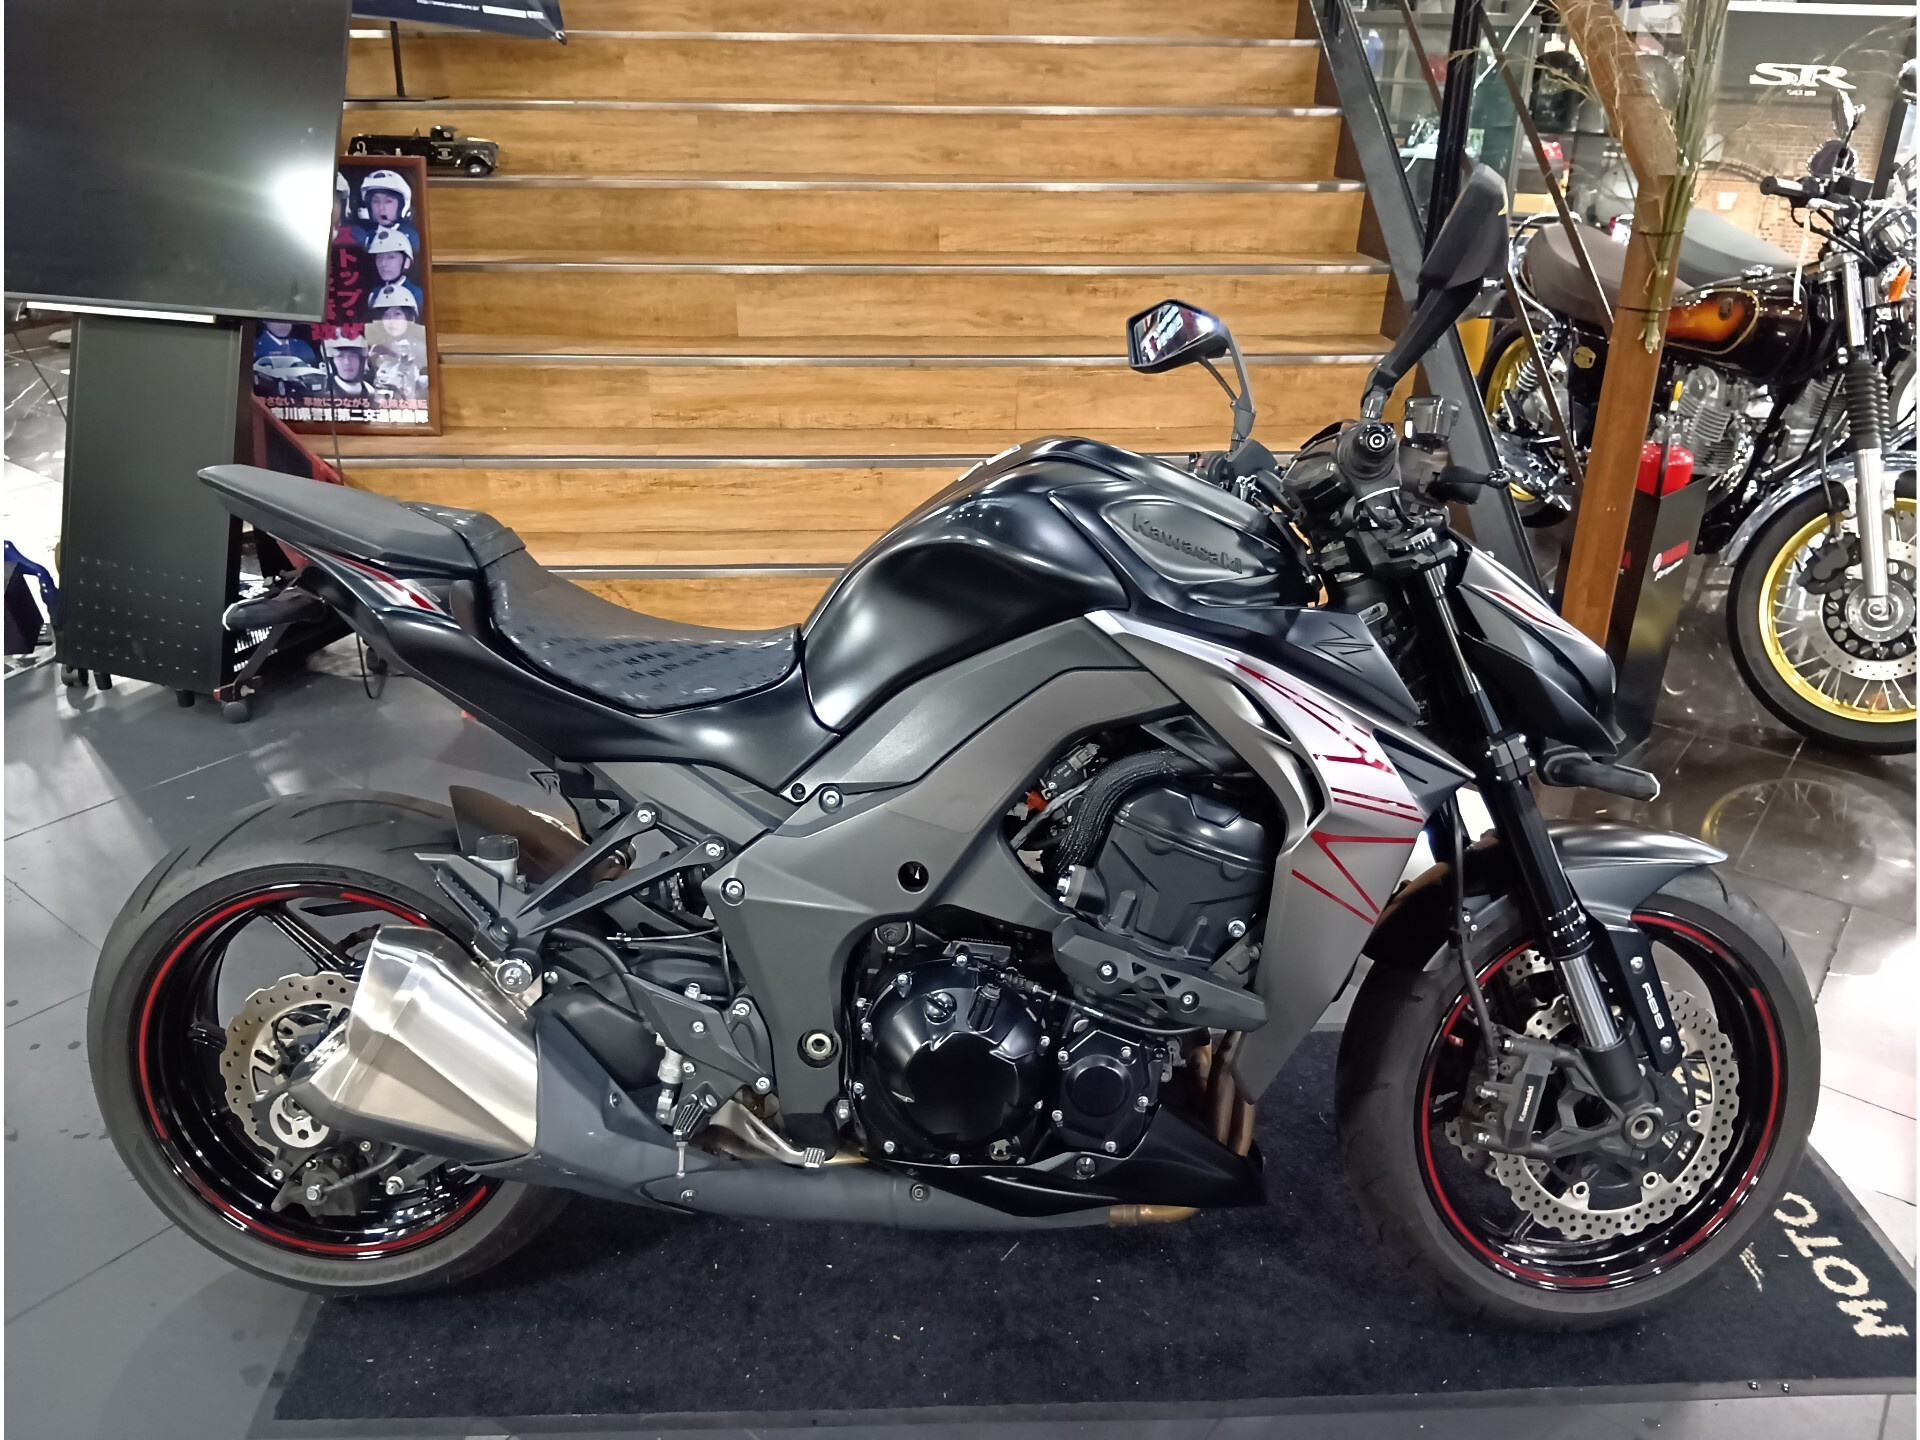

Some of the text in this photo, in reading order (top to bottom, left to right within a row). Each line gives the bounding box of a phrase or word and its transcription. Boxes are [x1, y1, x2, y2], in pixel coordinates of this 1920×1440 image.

[1131, 512, 1243, 575] Kawasaki
[1641, 981, 1665, 1030] ABS
[1518, 1085, 1535, 1123] Kawasaki
